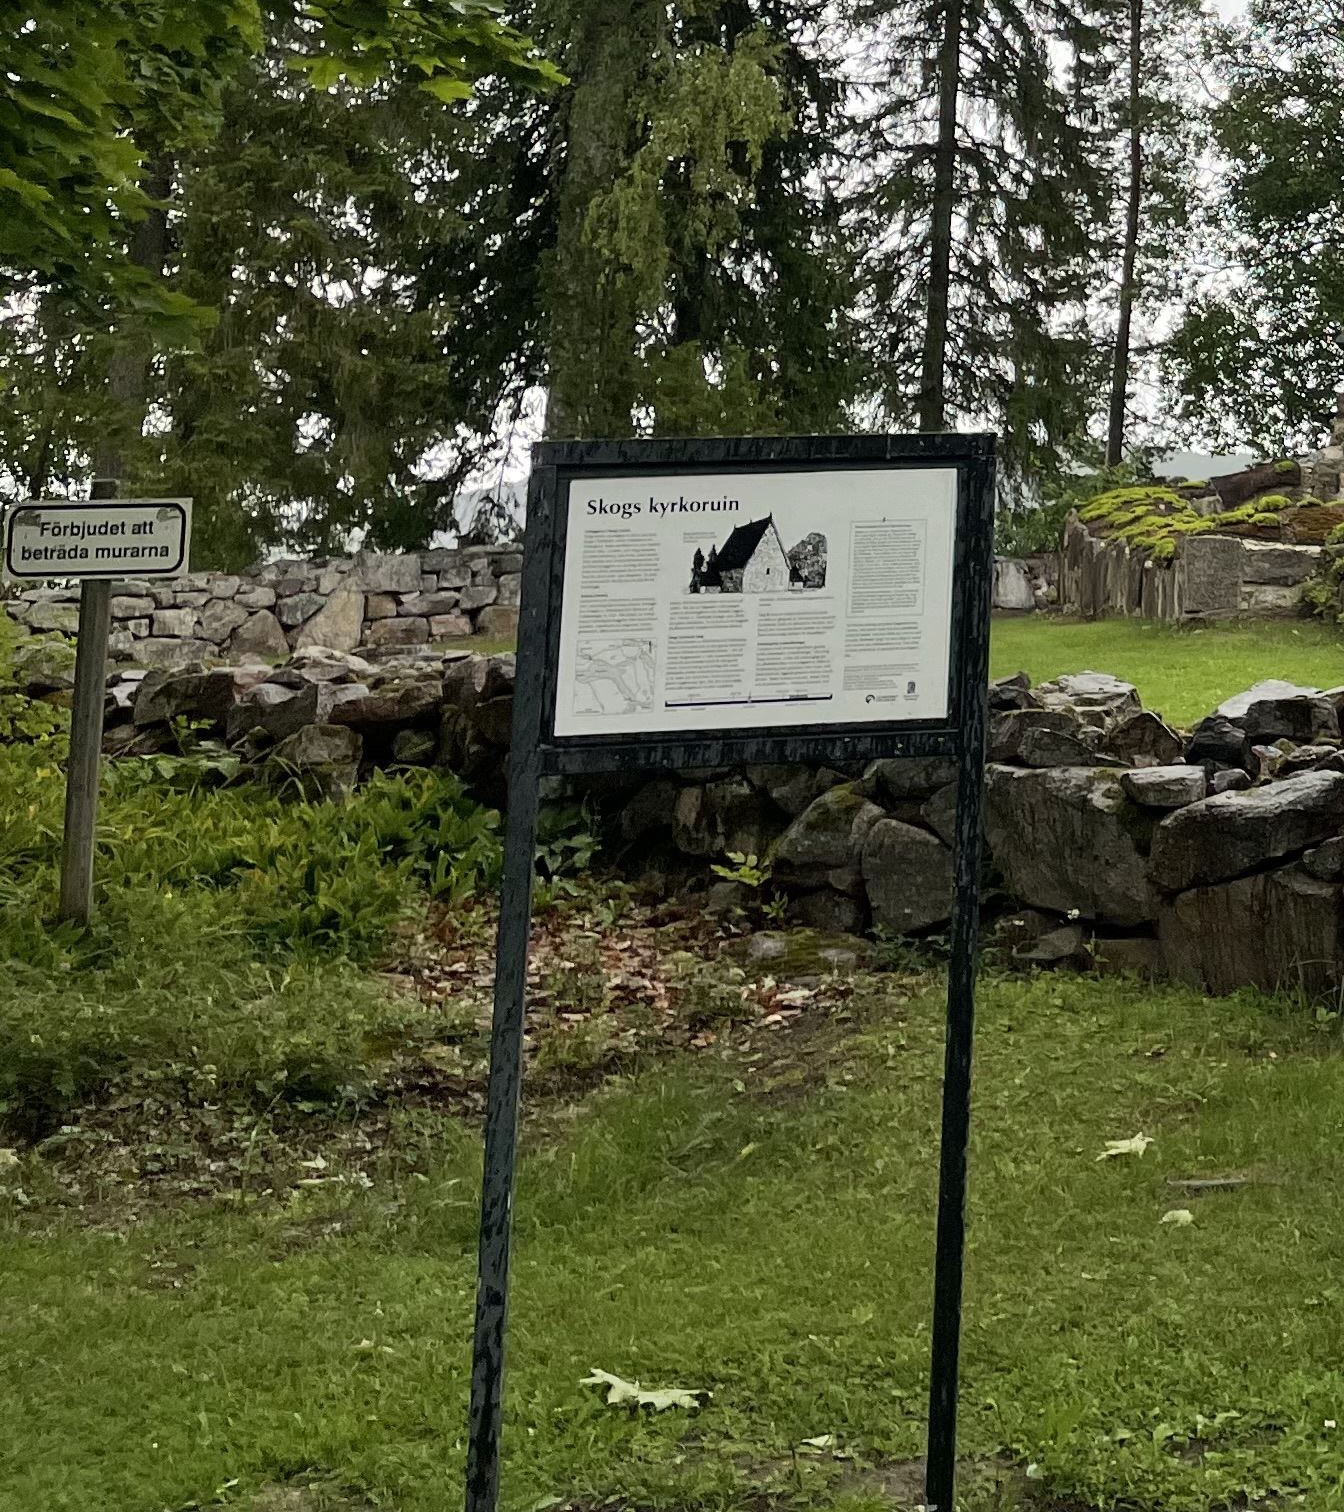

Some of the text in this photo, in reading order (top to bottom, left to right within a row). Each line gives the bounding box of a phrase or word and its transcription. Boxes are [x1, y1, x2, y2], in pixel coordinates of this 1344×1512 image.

[587, 496, 739, 519] Skogs kyrkoruin
[40, 521, 154, 540] Förbjudet att
[21, 544, 169, 561] beträda murarna
